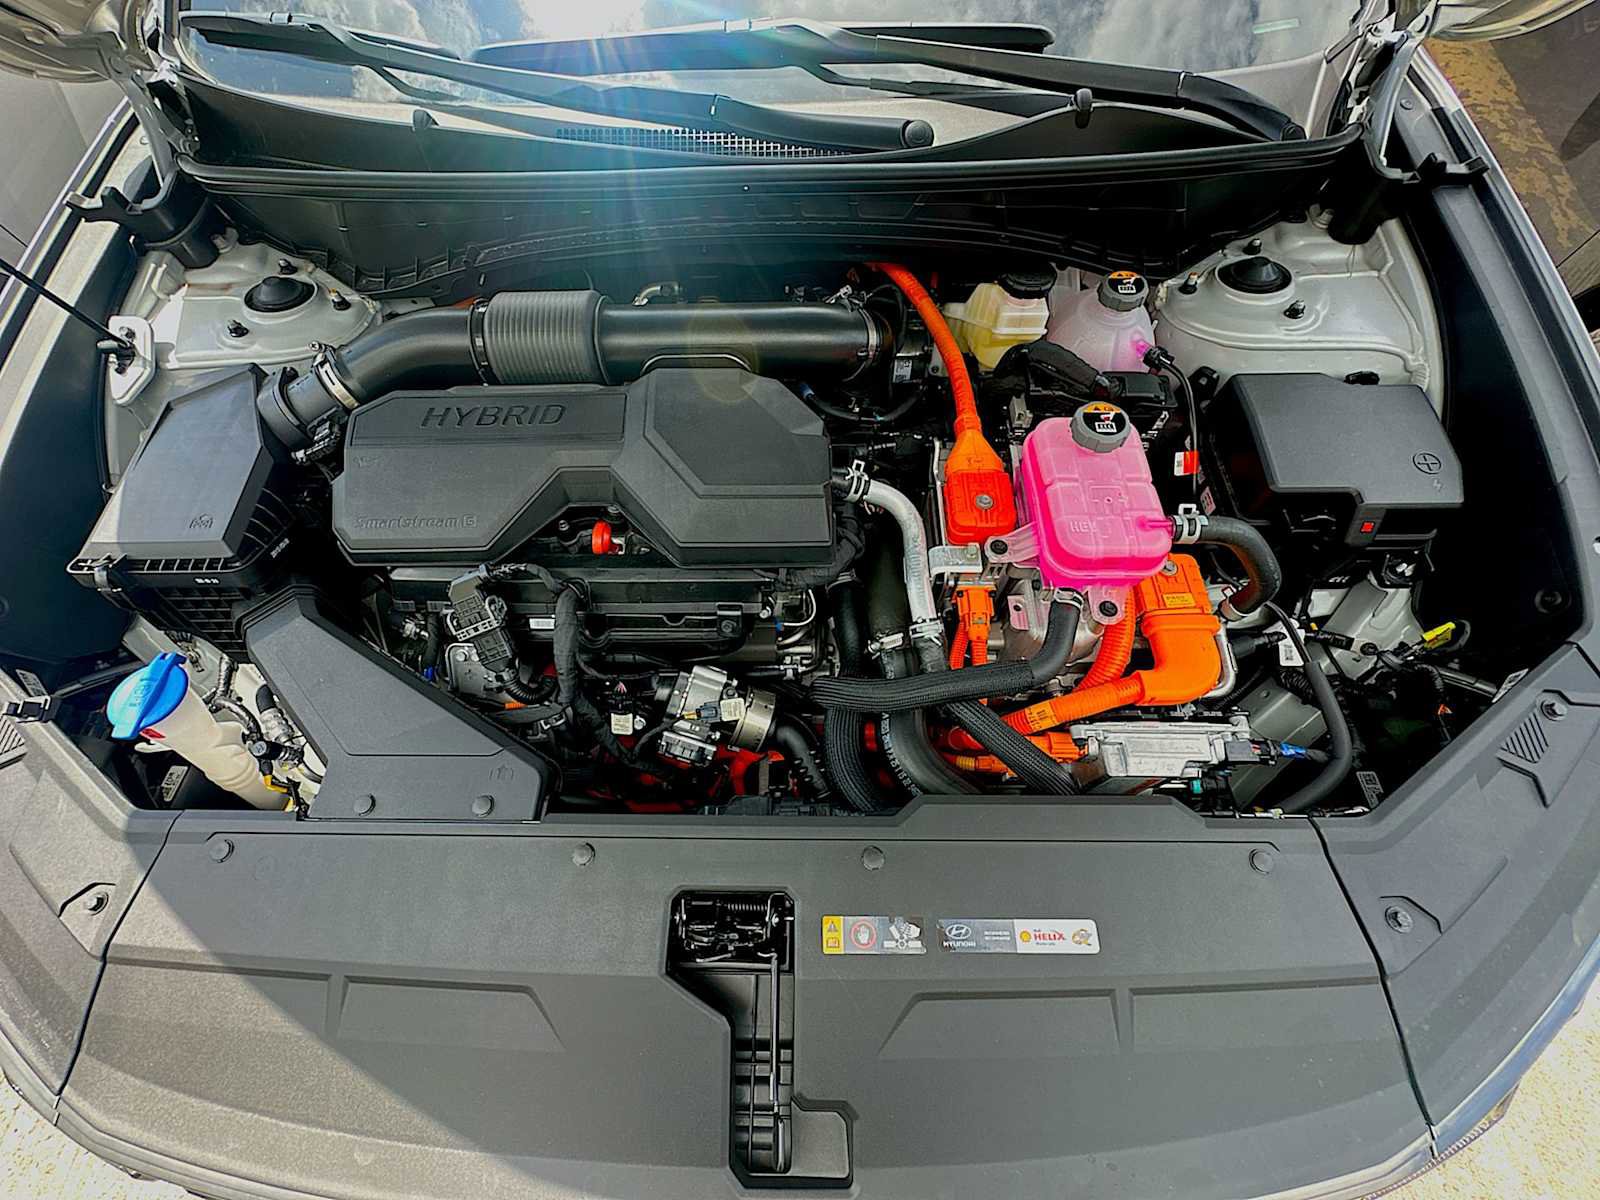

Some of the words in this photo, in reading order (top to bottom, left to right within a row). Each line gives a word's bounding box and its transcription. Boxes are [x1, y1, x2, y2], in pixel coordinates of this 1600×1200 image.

[420, 404, 567, 427] HYBRID
[354, 514, 459, 529] Smartstream
[1033, 931, 1066, 941] HELIX
[942, 940, 976, 948] HYUNDAI
